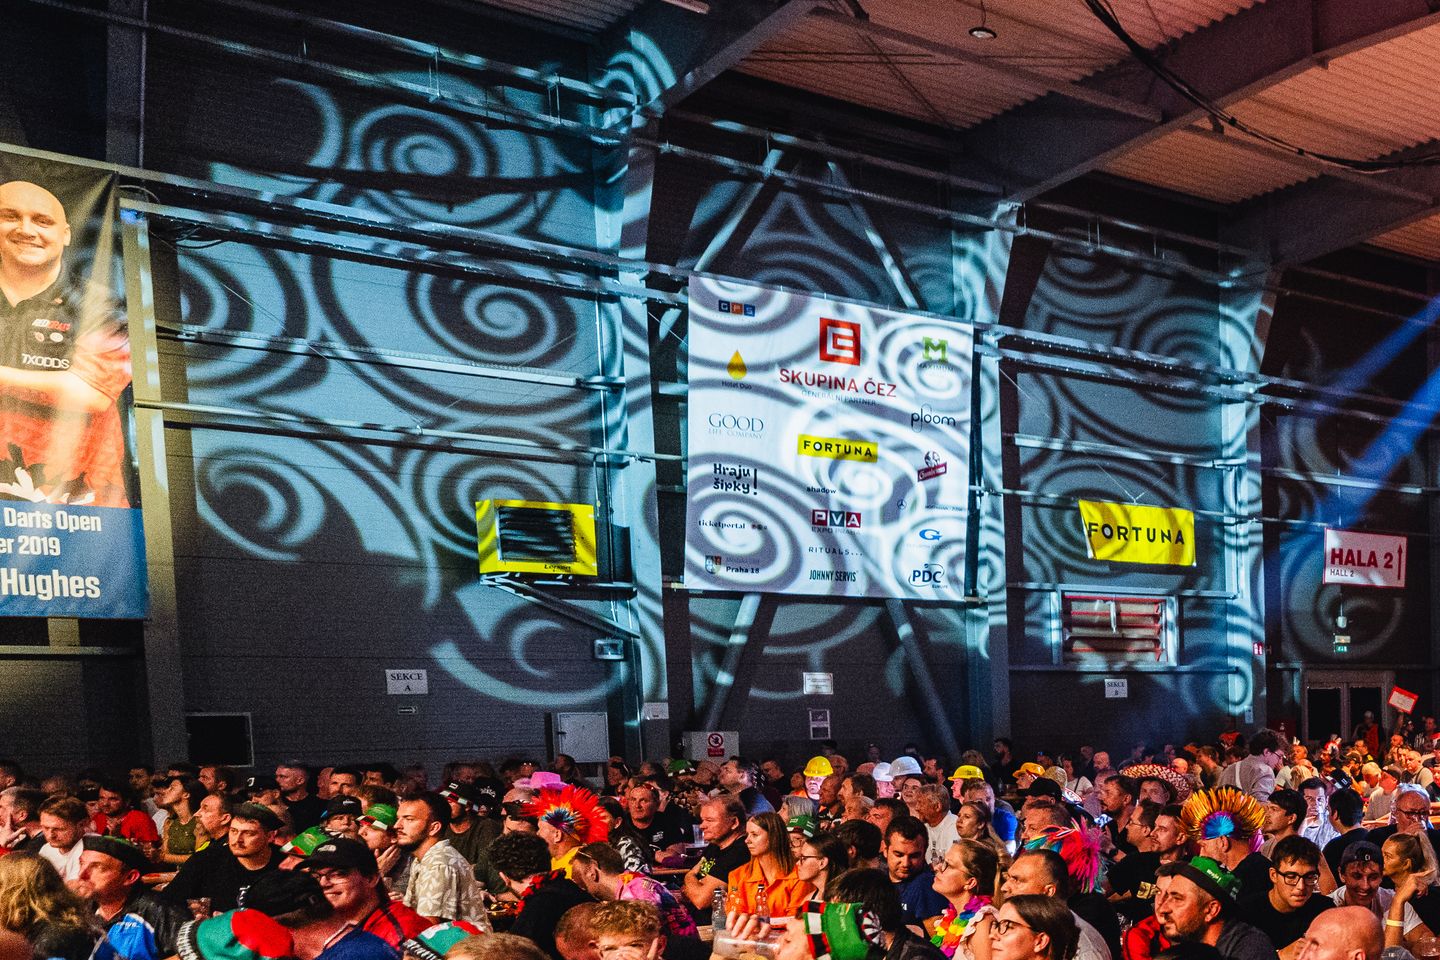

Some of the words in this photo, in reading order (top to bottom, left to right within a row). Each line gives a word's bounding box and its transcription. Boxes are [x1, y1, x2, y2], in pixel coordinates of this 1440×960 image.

[22, 354, 70, 369] TXODDS
[780, 368, 858, 392] SKUPINA
[864, 377, 897, 398] ČEZ
[709, 413, 764, 433] GOOD
[911, 403, 955, 433] ploom
[803, 440, 873, 457] FORTUNA
[713, 463, 750, 480] Hraju
[806, 486, 837, 494] shadow
[4, 507, 52, 529] Darts
[55, 510, 102, 533] Open
[698, 520, 746, 530] ticketportal
[814, 511, 860, 527] PVA
[1087, 522, 1185, 545] FORTUNA
[18, 535, 61, 556] 2019
[1330, 548, 1378, 568] HALA
[1383, 554, 1394, 569] 2
[809, 570, 834, 580] JOHNNY
[835, 571, 857, 582] SERVIS
[912, 570, 942, 583] PDC
[1330, 568, 1349, 577] HALL
[0, 567, 101, 601] Hughes
[390, 673, 423, 681] SEKCE
